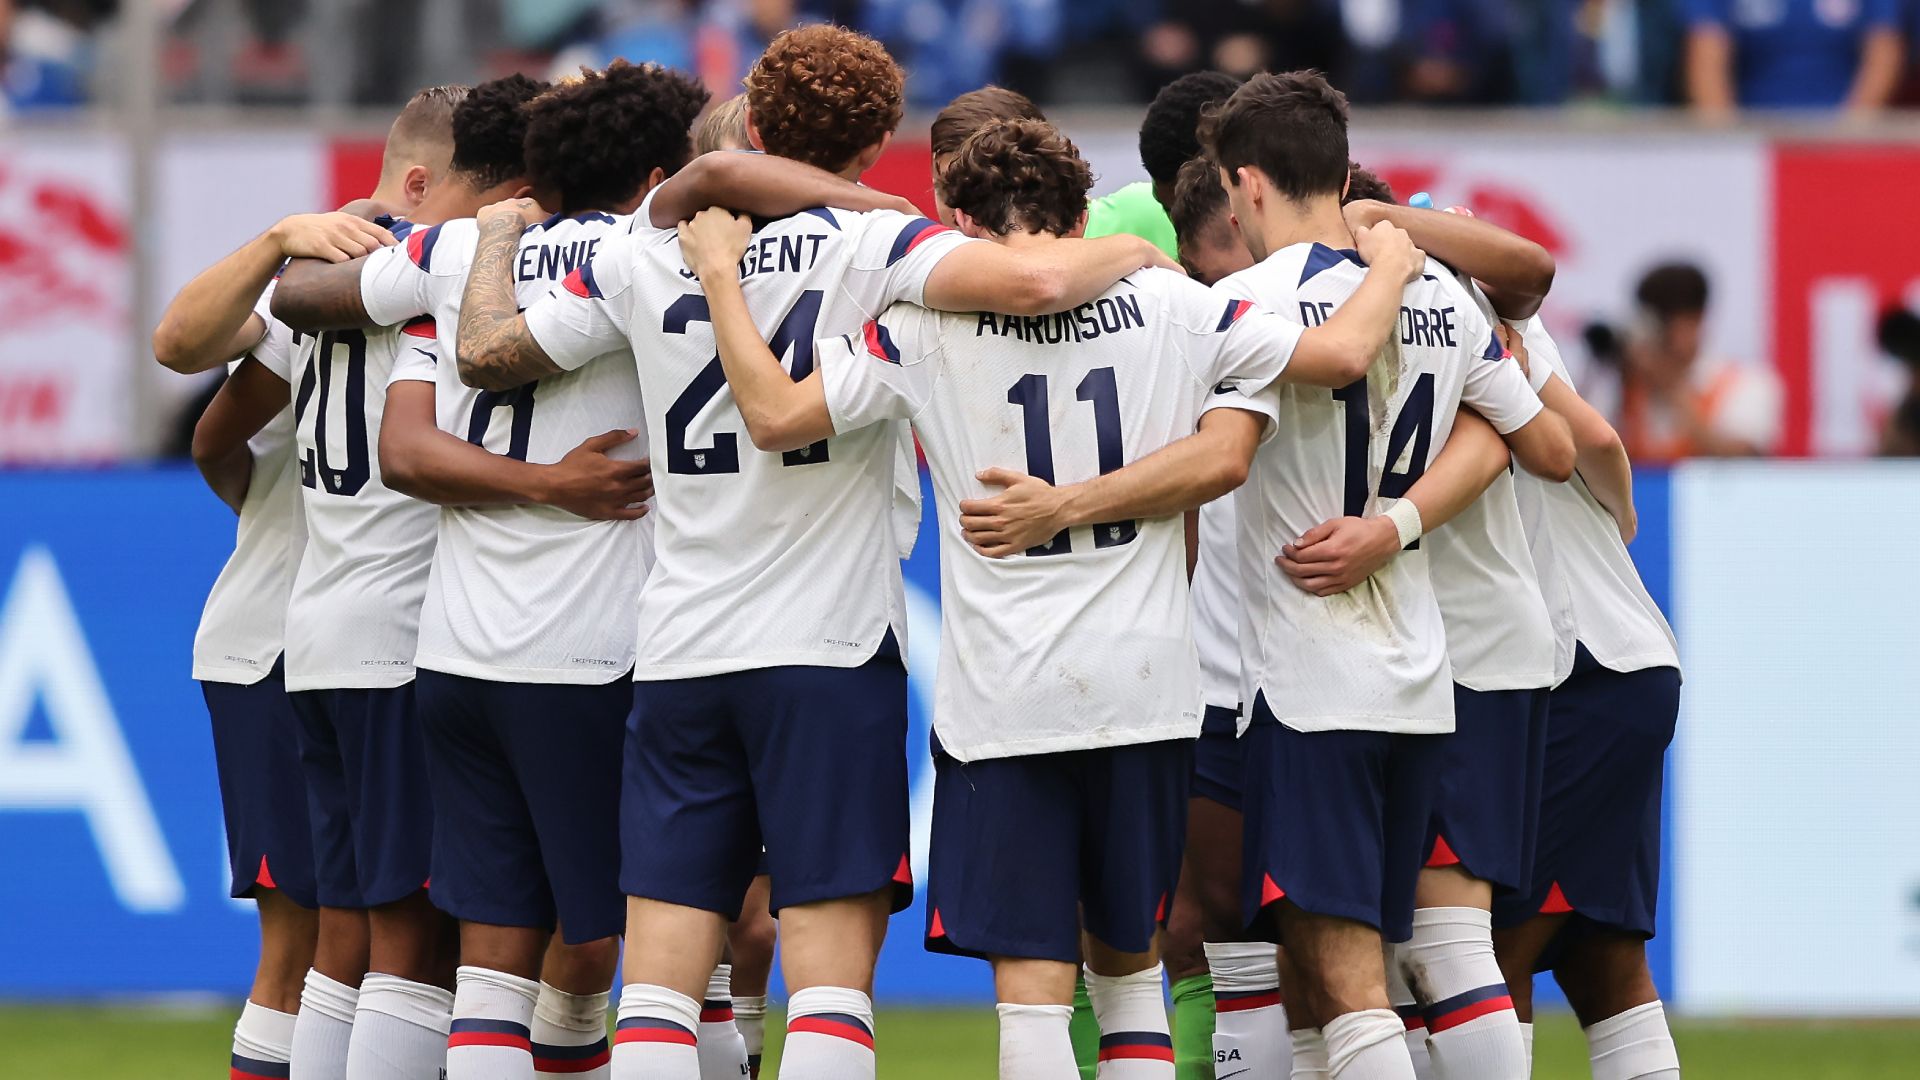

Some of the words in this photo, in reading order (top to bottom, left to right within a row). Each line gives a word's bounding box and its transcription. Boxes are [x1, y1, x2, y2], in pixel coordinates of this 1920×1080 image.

[662, 289, 829, 475] 24
[976, 294, 1145, 344] AARONSON
[1400, 305, 1457, 347] ORRE
[1007, 366, 1138, 557] 11
[1332, 372, 1435, 551] 14
